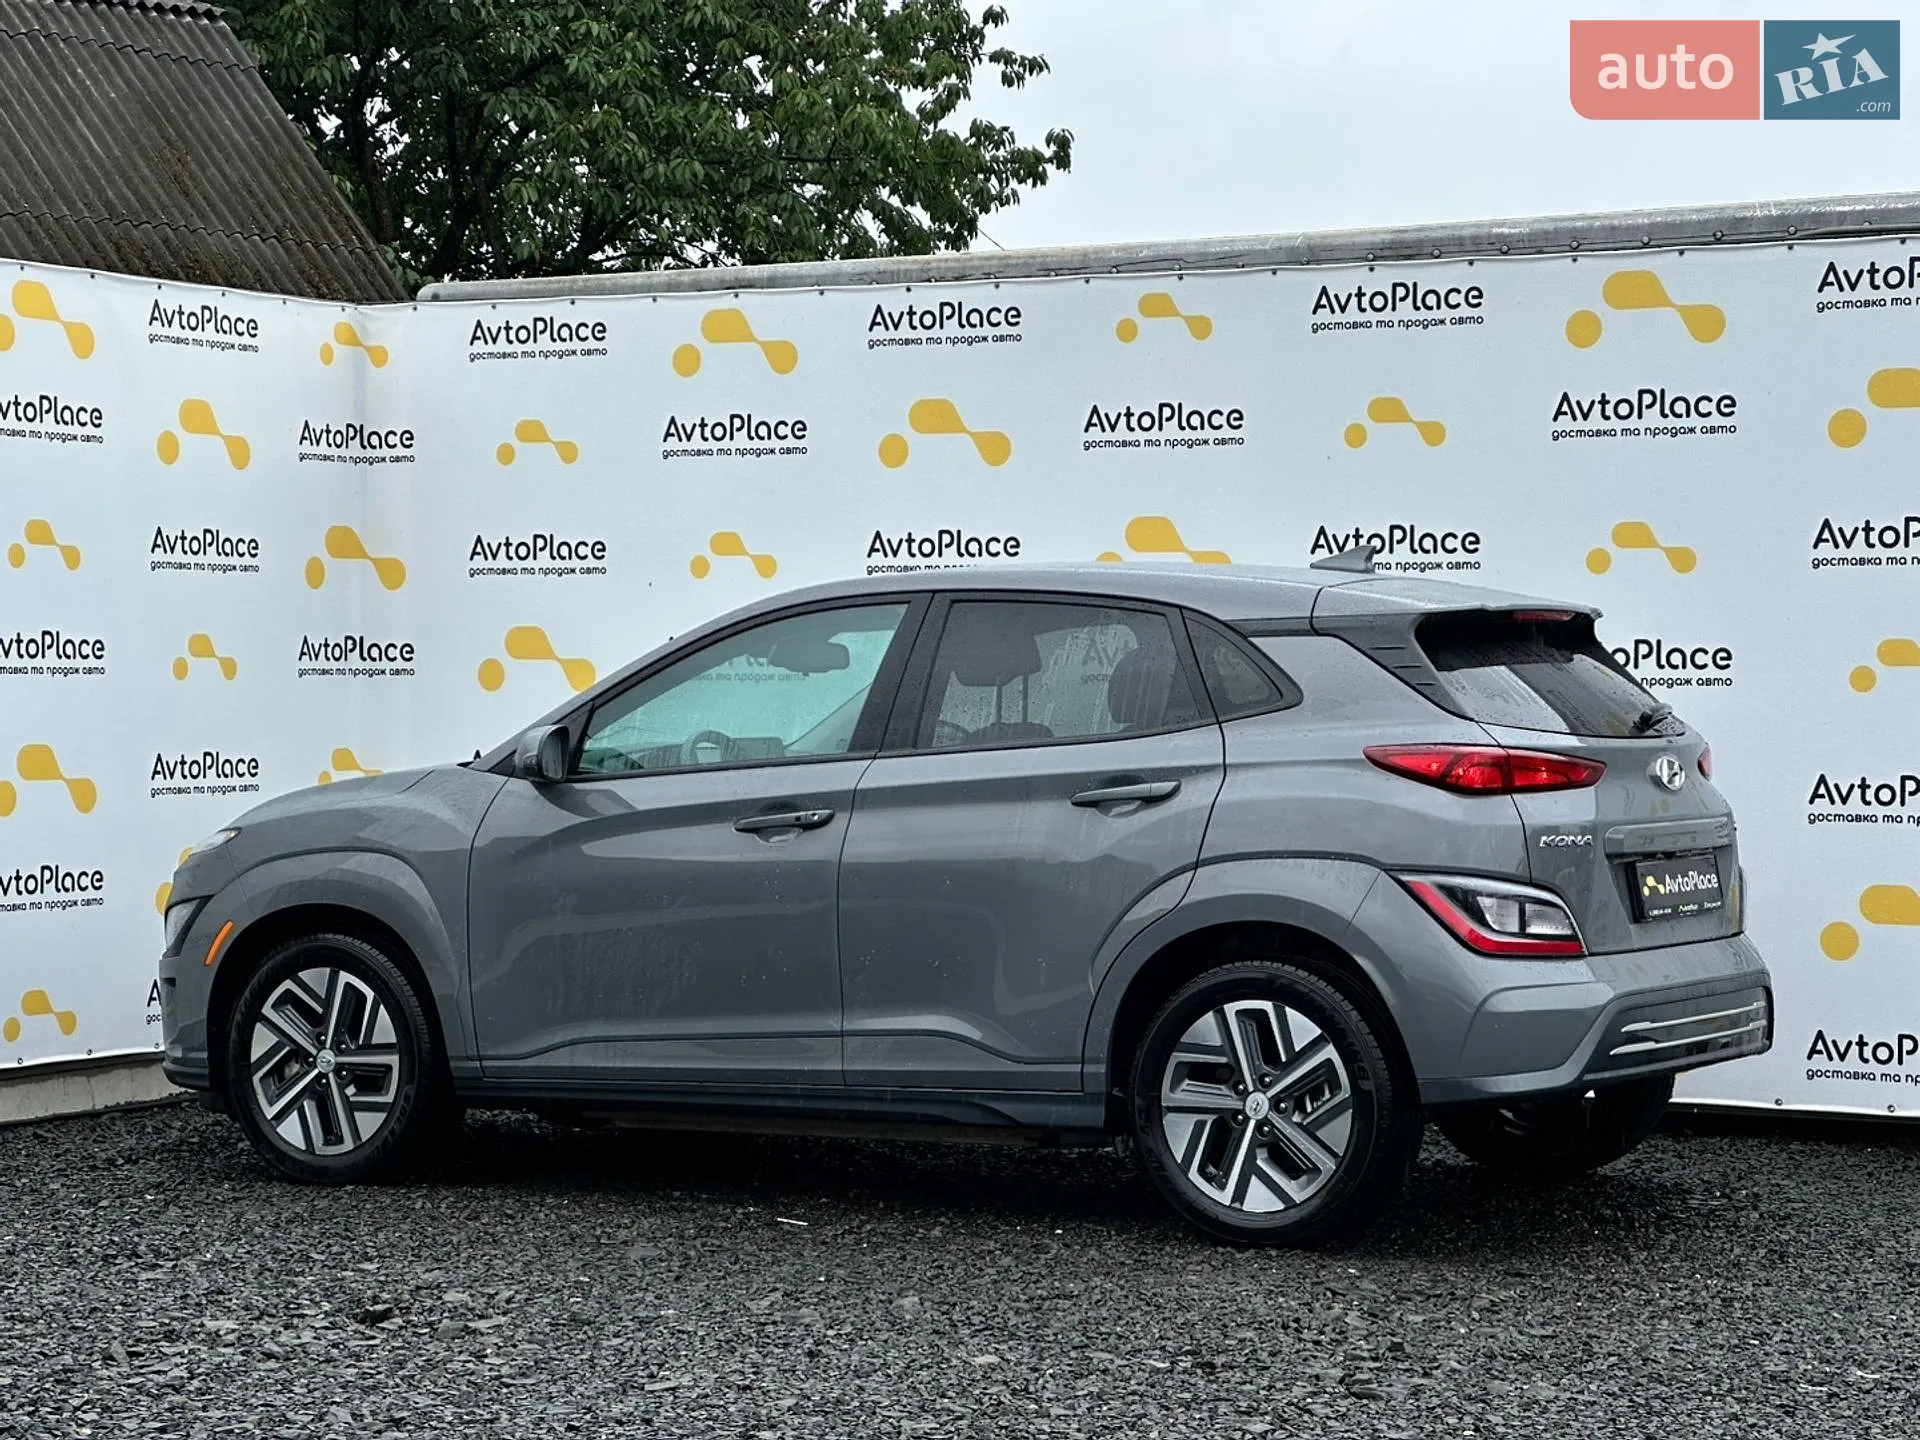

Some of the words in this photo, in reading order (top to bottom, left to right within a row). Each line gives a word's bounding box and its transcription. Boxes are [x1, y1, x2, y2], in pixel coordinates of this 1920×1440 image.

[1312, 281, 1484, 316] AvtoPlace
[1816, 298, 1887, 313] доставка
[1890, 297, 1912, 307] та
[148, 299, 258, 338] AvtoPlace
[868, 301, 1022, 333] AvtoPlace
[1311, 320, 1373, 334] доставка
[1376, 319, 1395, 329] та
[1398, 317, 1447, 330] продаж
[1449, 315, 1484, 326] авто
[469, 316, 607, 346] AvtoPlace
[148, 333, 190, 346] доставка
[191, 338, 204, 347] та
[205, 339, 235, 352] продаж
[237, 343, 259, 353] авто
[867, 337, 923, 350] доставка
[925, 336, 943, 345] та
[945, 335, 989, 347] продаж
[991, 333, 1022, 343] авто
[469, 351, 519, 363] доставка
[520, 350, 536, 358] та
[538, 349, 578, 360] продаж
[580, 348, 608, 357] авто
[1552, 388, 1737, 423] AvtoPlace
[1083, 402, 1244, 434] AvtoPlace
[299, 419, 414, 450] AvtoPlace
[662, 413, 808, 443] AvtoPlace
[1551, 428, 1617, 442] доставка
[1620, 427, 1641, 437] та
[1644, 426, 1697, 439] продаж
[1700, 425, 1737, 435] авто
[28, 430, 42, 439] та
[44, 431, 78, 444] продаж
[80, 434, 104, 444] авто
[1083, 439, 1141, 451] доставка
[1144, 439, 1161, 448] та
[1164, 438, 1210, 450] продаж
[1212, 437, 1245, 446] авто
[298, 452, 335, 462] доставка
[336, 455, 347, 463] та
[348, 456, 387, 466] продаж
[388, 455, 415, 463] авто
[662, 448, 714, 460] доставка
[716, 448, 732, 456] та
[735, 447, 776, 458] продаж
[778, 446, 808, 455] авто
[150, 526, 259, 559] AvtoPlace
[469, 533, 606, 562] AvtoPlace
[867, 529, 1021, 558] AvtoPlace
[1310, 524, 1481, 555] AvtoPlace
[150, 560, 192, 572] доставка
[193, 562, 206, 571] та
[207, 563, 237, 574] продаж
[239, 564, 260, 573] авто
[1396, 561, 1443, 573] продаж
[1446, 560, 1481, 570] авто
[1811, 557, 1882, 570] доставка
[1886, 556, 1907, 566] та
[468, 567, 518, 578] доставка
[520, 567, 536, 575] та
[538, 567, 577, 578] продаж
[579, 566, 607, 575] авто
[298, 635, 415, 663] AvtoPlace
[30, 666, 44, 675] та
[46, 666, 80, 678] продаж
[82, 666, 106, 675] авто
[297, 668, 334, 678] доставка
[335, 668, 347, 676] та
[348, 668, 387, 678] продаж
[389, 668, 415, 676] авто
[1696, 677, 1733, 687] авто
[151, 751, 259, 781] AvtoPlace
[150, 786, 192, 799] доставка
[193, 786, 205, 794] та
[207, 785, 237, 796] продаж
[238, 784, 260, 793] авто
[1807, 812, 1878, 825] доставка
[1882, 814, 1903, 824] та
[1540, 834, 1594, 848] KONA
[1664, 870, 1719, 894] AvtoPlace
[29, 901, 43, 910] та
[44, 899, 79, 912] продаж
[80, 897, 104, 907] авто
[1806, 1029, 1919, 1066] AvtoP
[1806, 1068, 1876, 1081] доставка
[1880, 1073, 1901, 1083] та
